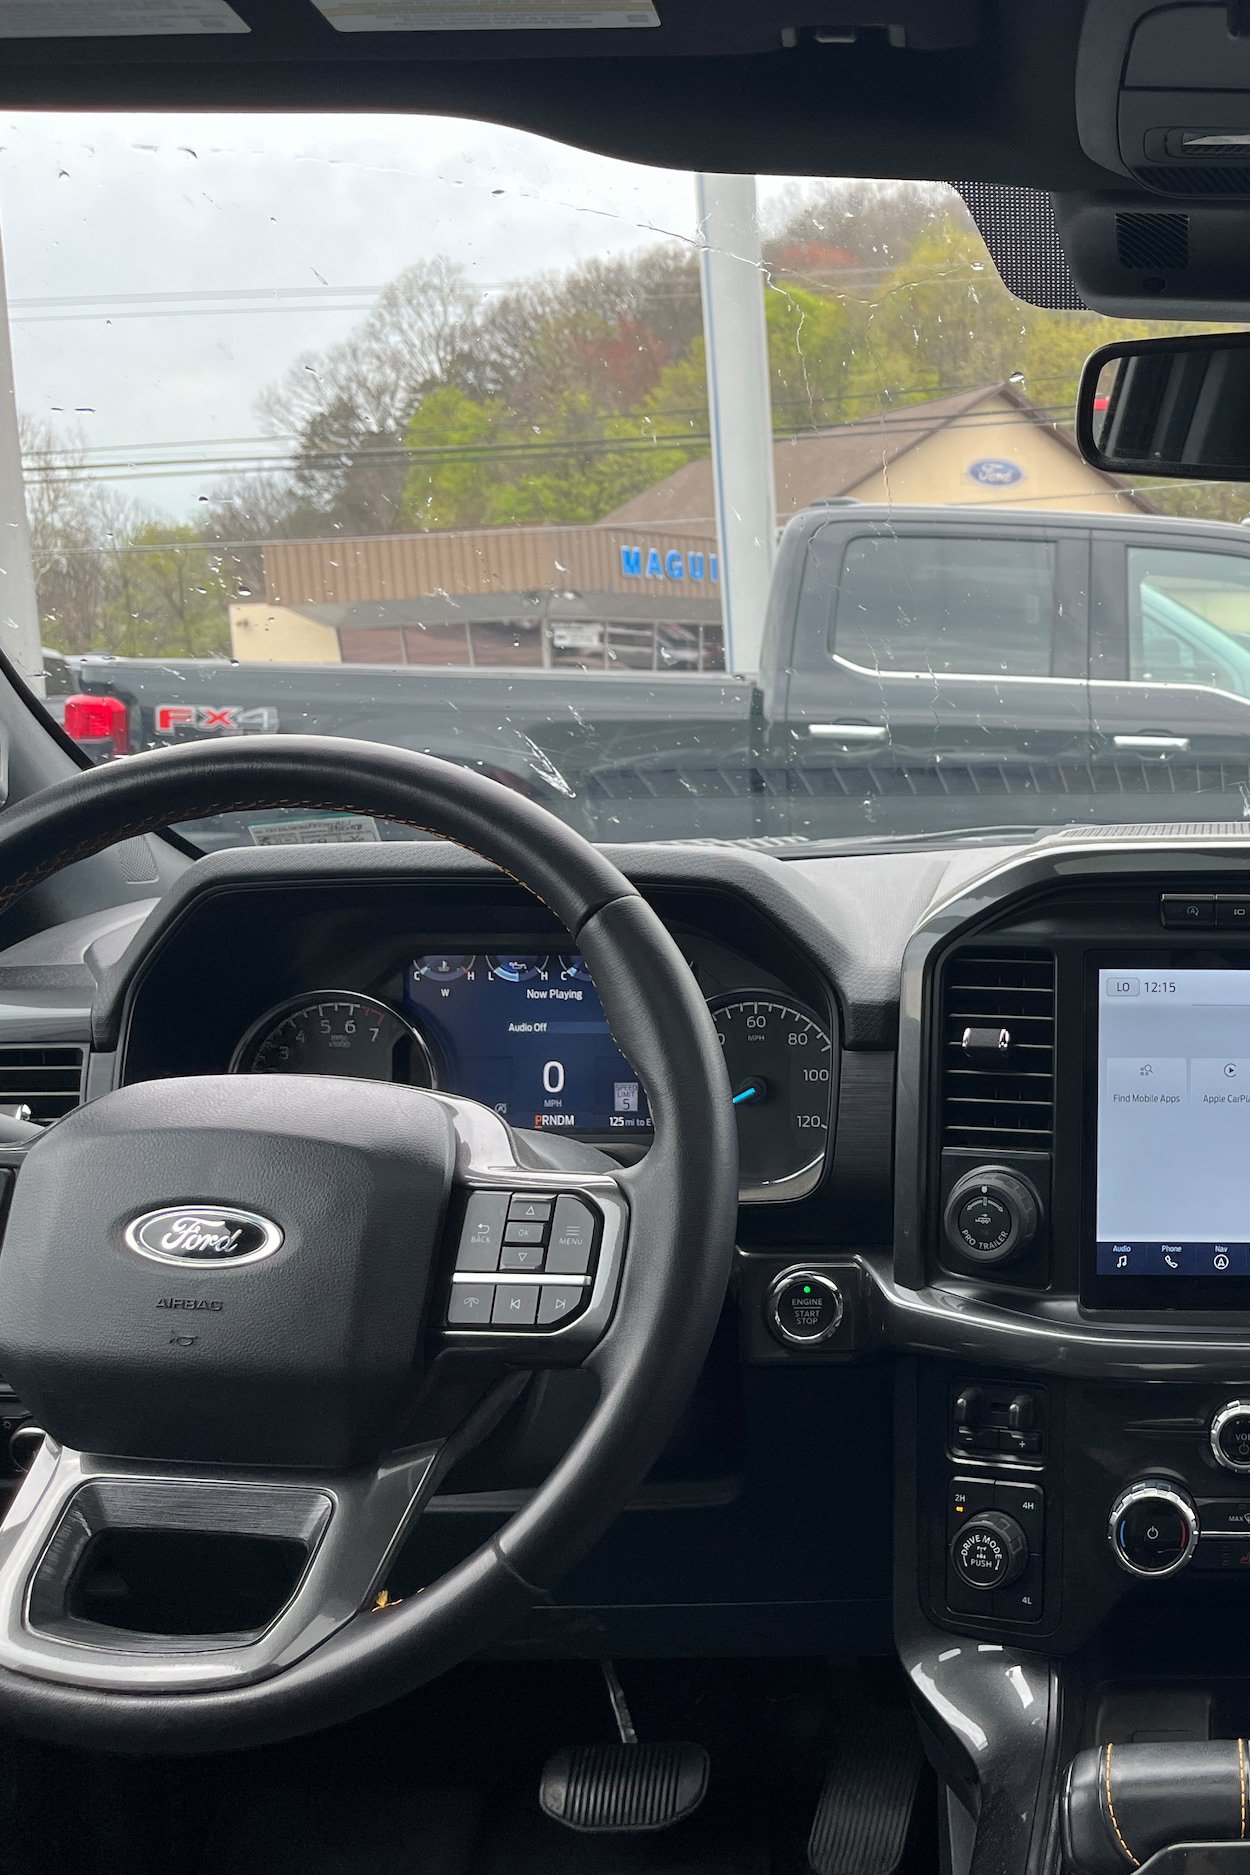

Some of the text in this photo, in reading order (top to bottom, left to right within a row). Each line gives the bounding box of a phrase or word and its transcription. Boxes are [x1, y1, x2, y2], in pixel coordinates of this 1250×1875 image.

[155, 704, 280, 735] FX4
[413, 972, 420, 981] C
[467, 972, 475, 981] H
[488, 972, 494, 981] L
[540, 972, 548, 981] H
[560, 972, 568, 981] C
[1116, 982, 1130, 992] LO
[1144, 982, 1176, 993] 12:15
[441, 989, 450, 997] W
[527, 989, 583, 1001] Now Playing
[321, 1020, 331, 1034] 5
[345, 1020, 356, 1034] 6
[747, 1016, 766, 1028] 60
[508, 1023, 547, 1032] Audio Off
[369, 1028, 379, 1042] 7
[788, 1033, 808, 1046] 80
[542, 1061, 565, 1093] 0
[803, 1069, 829, 1081] 100
[544, 1100, 562, 1108] MPH
[622, 1098, 630, 1110] 5
[1113, 1094, 1180, 1104] Find Mobile Apps
[1203, 1095, 1227, 1104] Apple
[609, 1116, 652, 1126] 125 mi to E
[797, 1115, 821, 1128] 120
[161, 1215, 243, 1254] Ford
[962, 1229, 1009, 1250] PRO TRAILER
[156, 1298, 224, 1311] AIRBAG
[791, 1298, 823, 1306] ENGINE
[954, 1494, 966, 1502] 2H
[1022, 1502, 1034, 1510] 4H
[961, 1534, 1002, 1560] DRIVE MODE
[970, 1559, 992, 1568] PUSH
[1022, 1597, 1032, 1605] 4L
